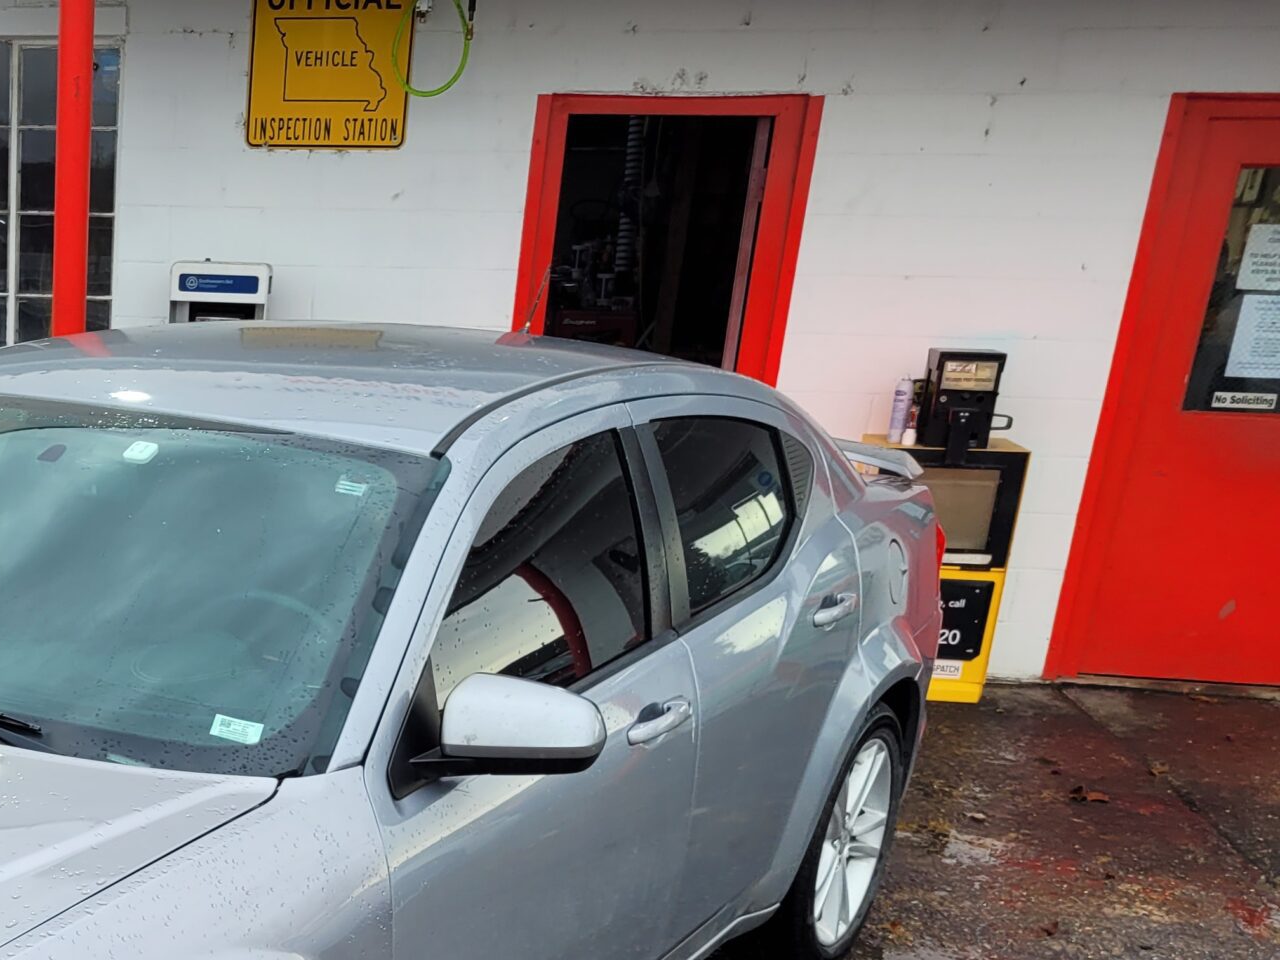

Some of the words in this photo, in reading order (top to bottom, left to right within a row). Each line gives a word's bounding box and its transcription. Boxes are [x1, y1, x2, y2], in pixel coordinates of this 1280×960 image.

[295, 51, 358, 67] VEHICLE
[254, 117, 331, 141] INSPECTION
[343, 118, 398, 141] STATION
[1214, 395, 1227, 404] No
[1229, 395, 1274, 408] Soliciting
[948, 598, 967, 608] call
[938, 628, 961, 645] 20
